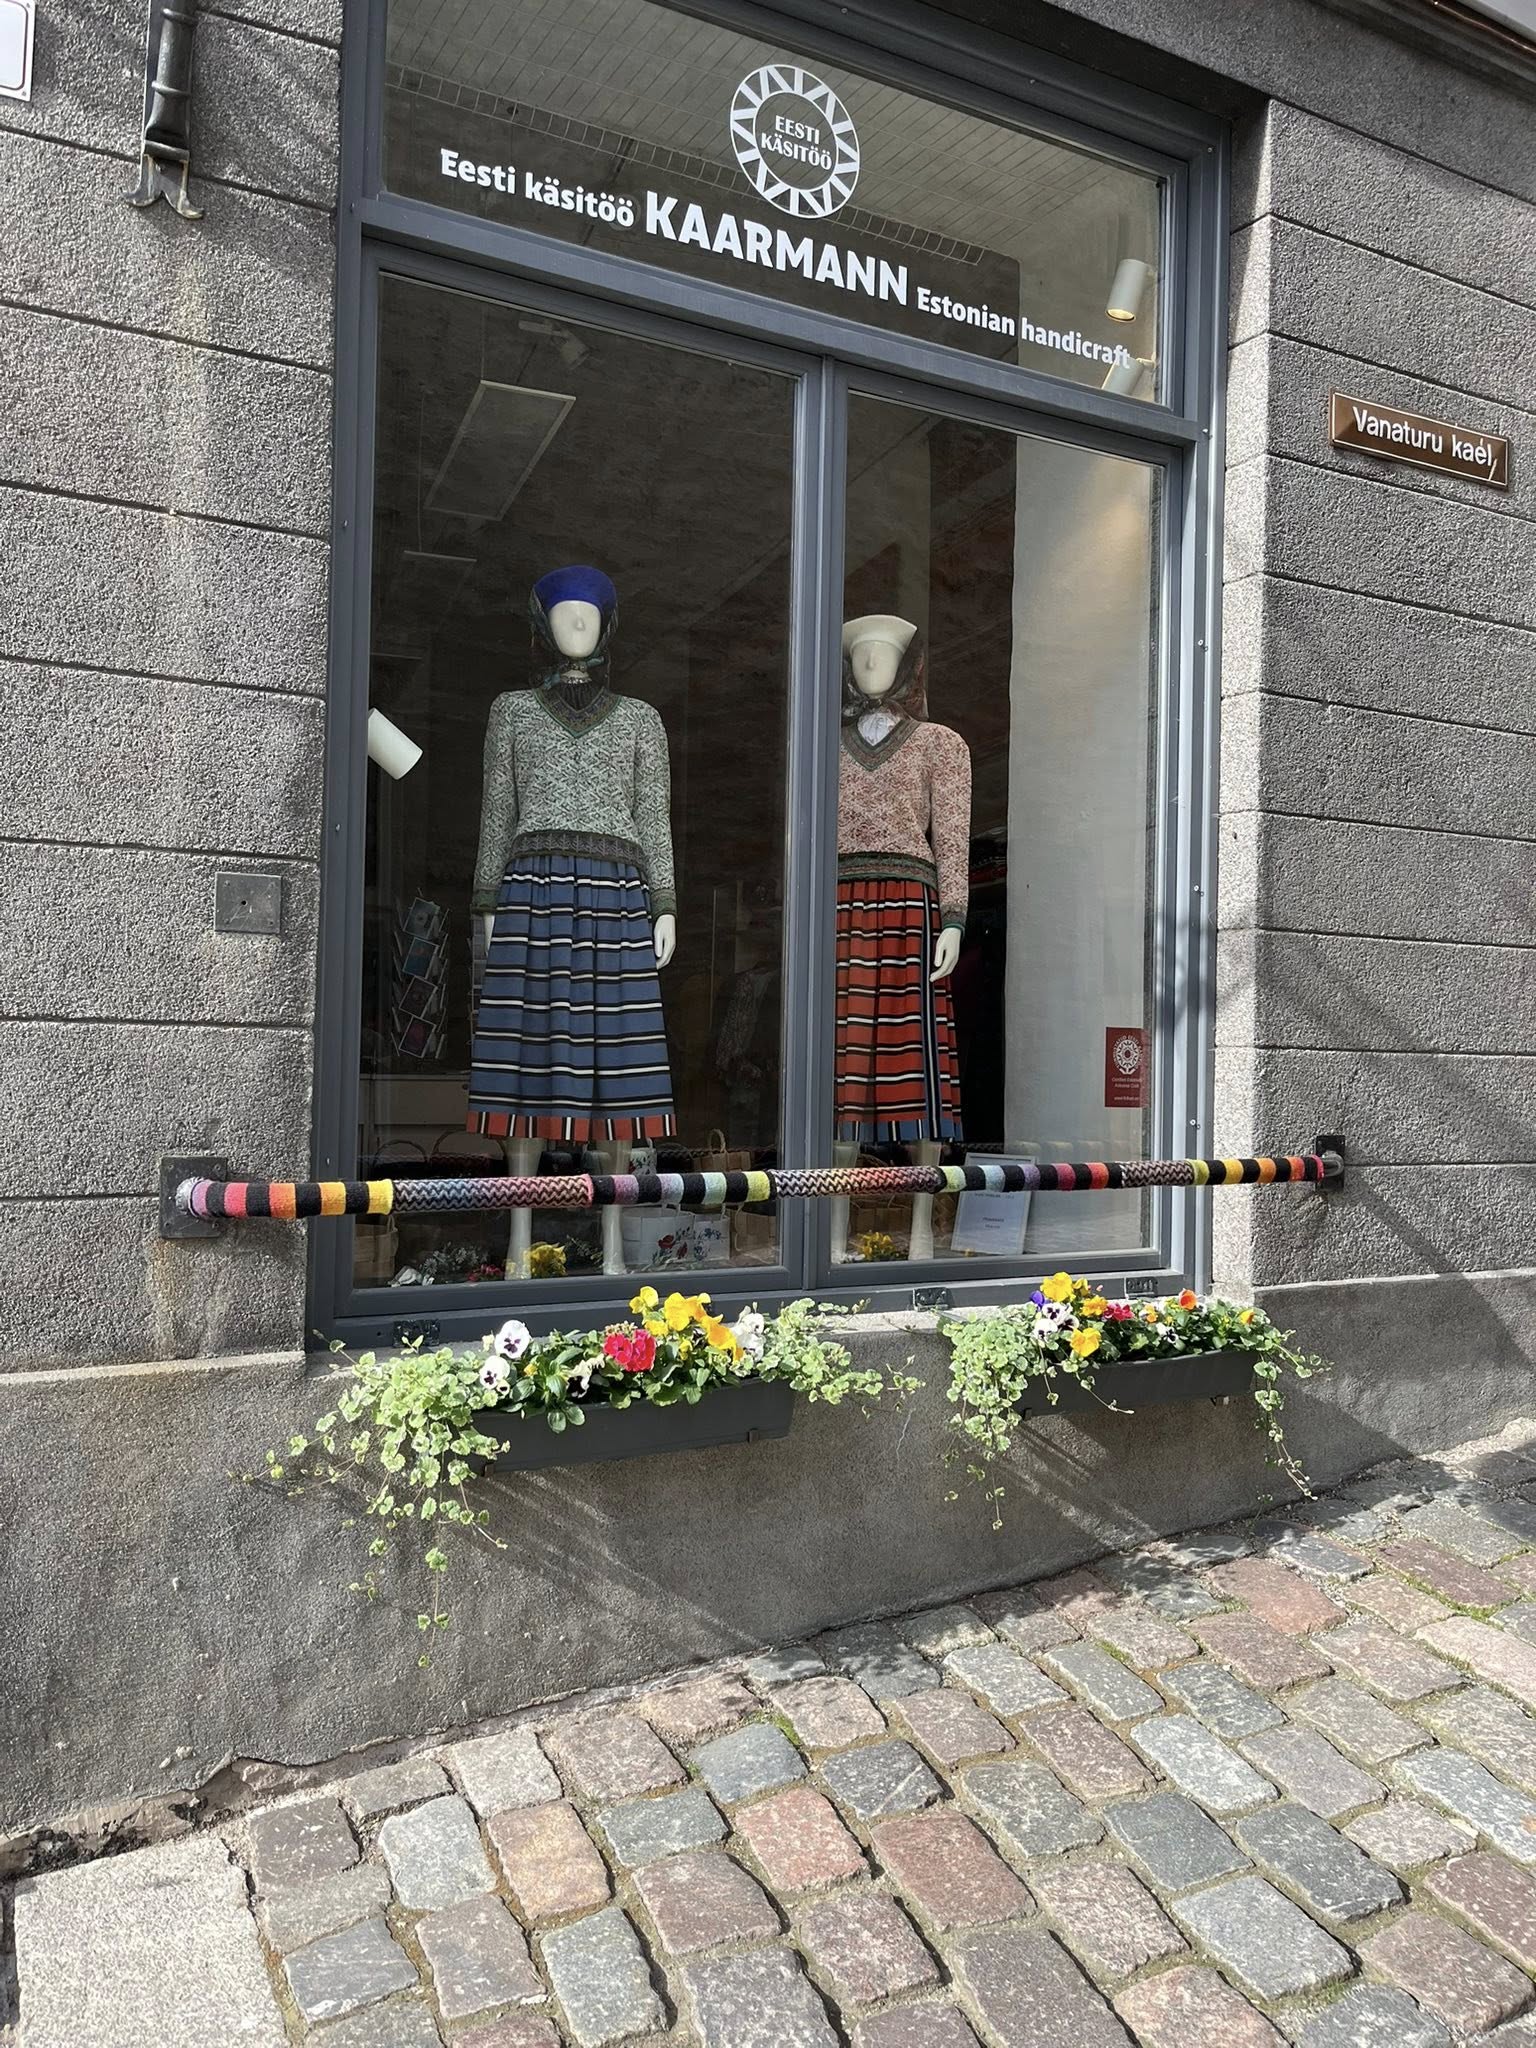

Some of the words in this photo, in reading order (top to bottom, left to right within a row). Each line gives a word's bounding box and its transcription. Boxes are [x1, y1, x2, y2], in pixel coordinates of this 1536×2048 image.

[761, 132, 832, 170] KÄSITÖÖ
[775, 115, 820, 145] EESTI
[441, 148, 516, 195] Eesti
[525, 172, 635, 227] käsitöö
[646, 190, 908, 306] KAARMANN
[917, 286, 1015, 337] Estonian
[1021, 317, 1131, 369] handicraft
[1352, 406, 1443, 453] Vanaturu
